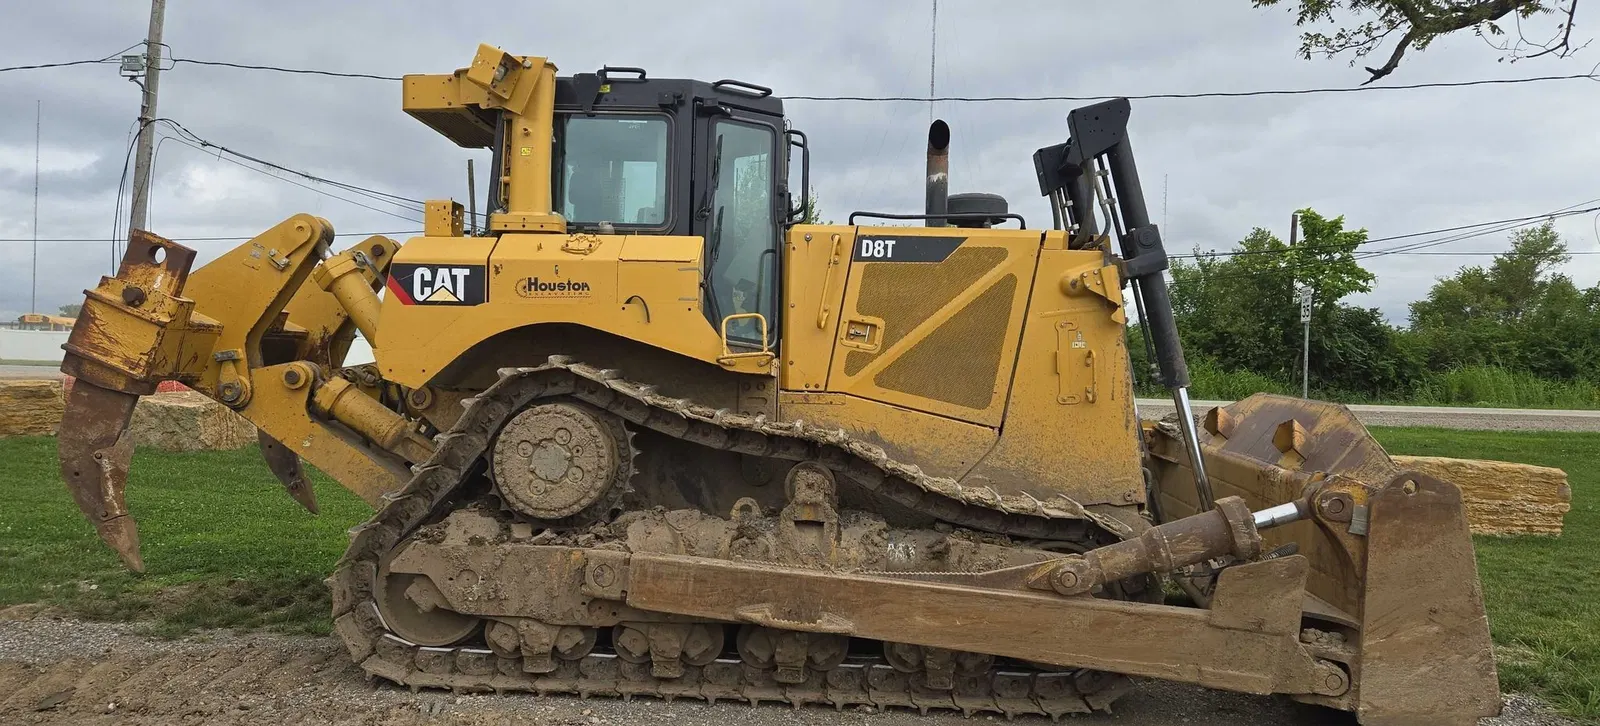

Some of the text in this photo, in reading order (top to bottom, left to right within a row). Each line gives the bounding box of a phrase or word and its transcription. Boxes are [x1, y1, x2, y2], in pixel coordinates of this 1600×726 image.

[861, 239, 896, 257] D8T
[413, 267, 470, 301] CAT
[527, 277, 590, 291] Houston
